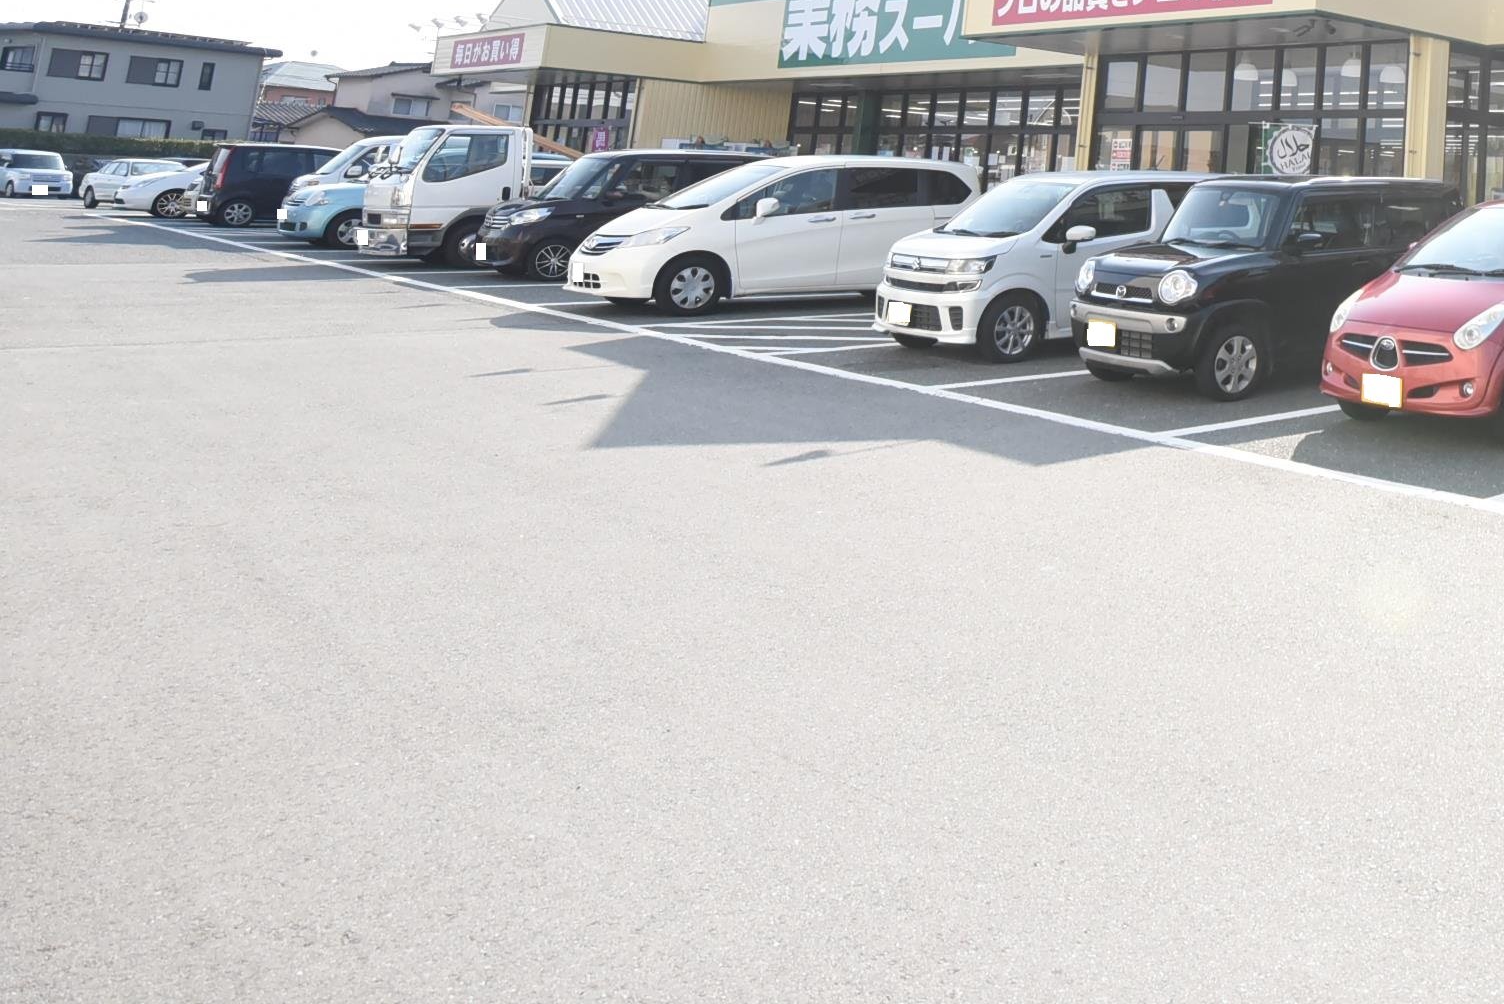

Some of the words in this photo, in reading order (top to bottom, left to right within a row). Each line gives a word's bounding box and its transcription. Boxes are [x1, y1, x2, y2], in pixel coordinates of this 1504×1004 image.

[455, 37, 520, 65] 毎日がお買い得
